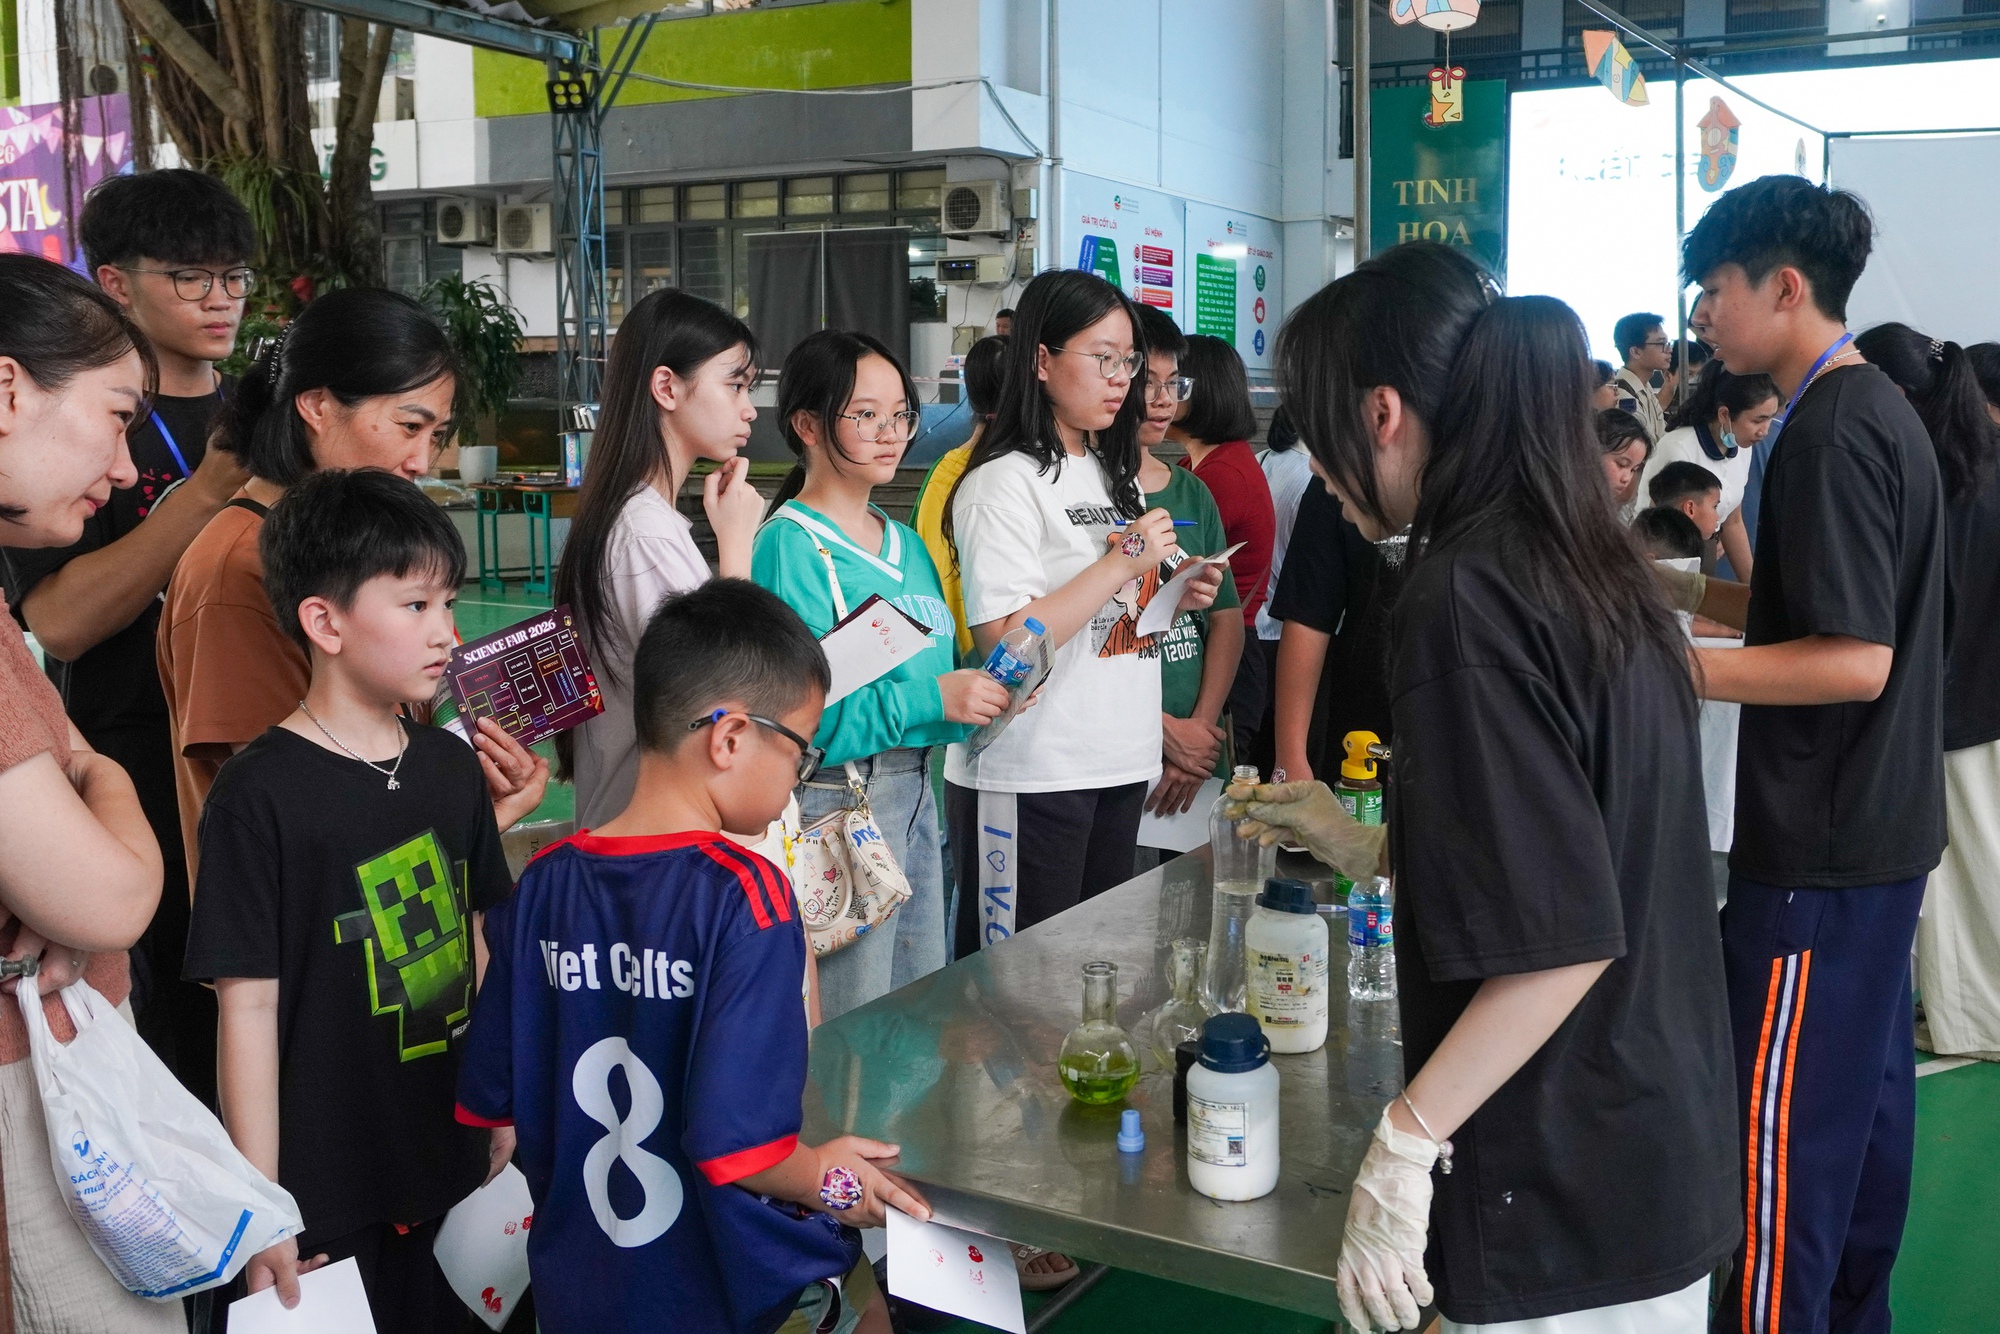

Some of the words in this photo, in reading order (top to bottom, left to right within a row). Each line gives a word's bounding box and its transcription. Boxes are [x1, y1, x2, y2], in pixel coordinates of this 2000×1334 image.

[1393, 178, 1477, 205] TINH
[1399, 221, 1472, 245] HOA
[463, 638, 507, 665] SCIENCE
[504, 630, 529, 649] FAIR
[528, 619, 556, 639] 2026
[539, 939, 601, 992] Viet
[610, 942, 695, 1000] Celts
[573, 1036, 684, 1248] 8
[70, 1168, 100, 1185] SÁCH
